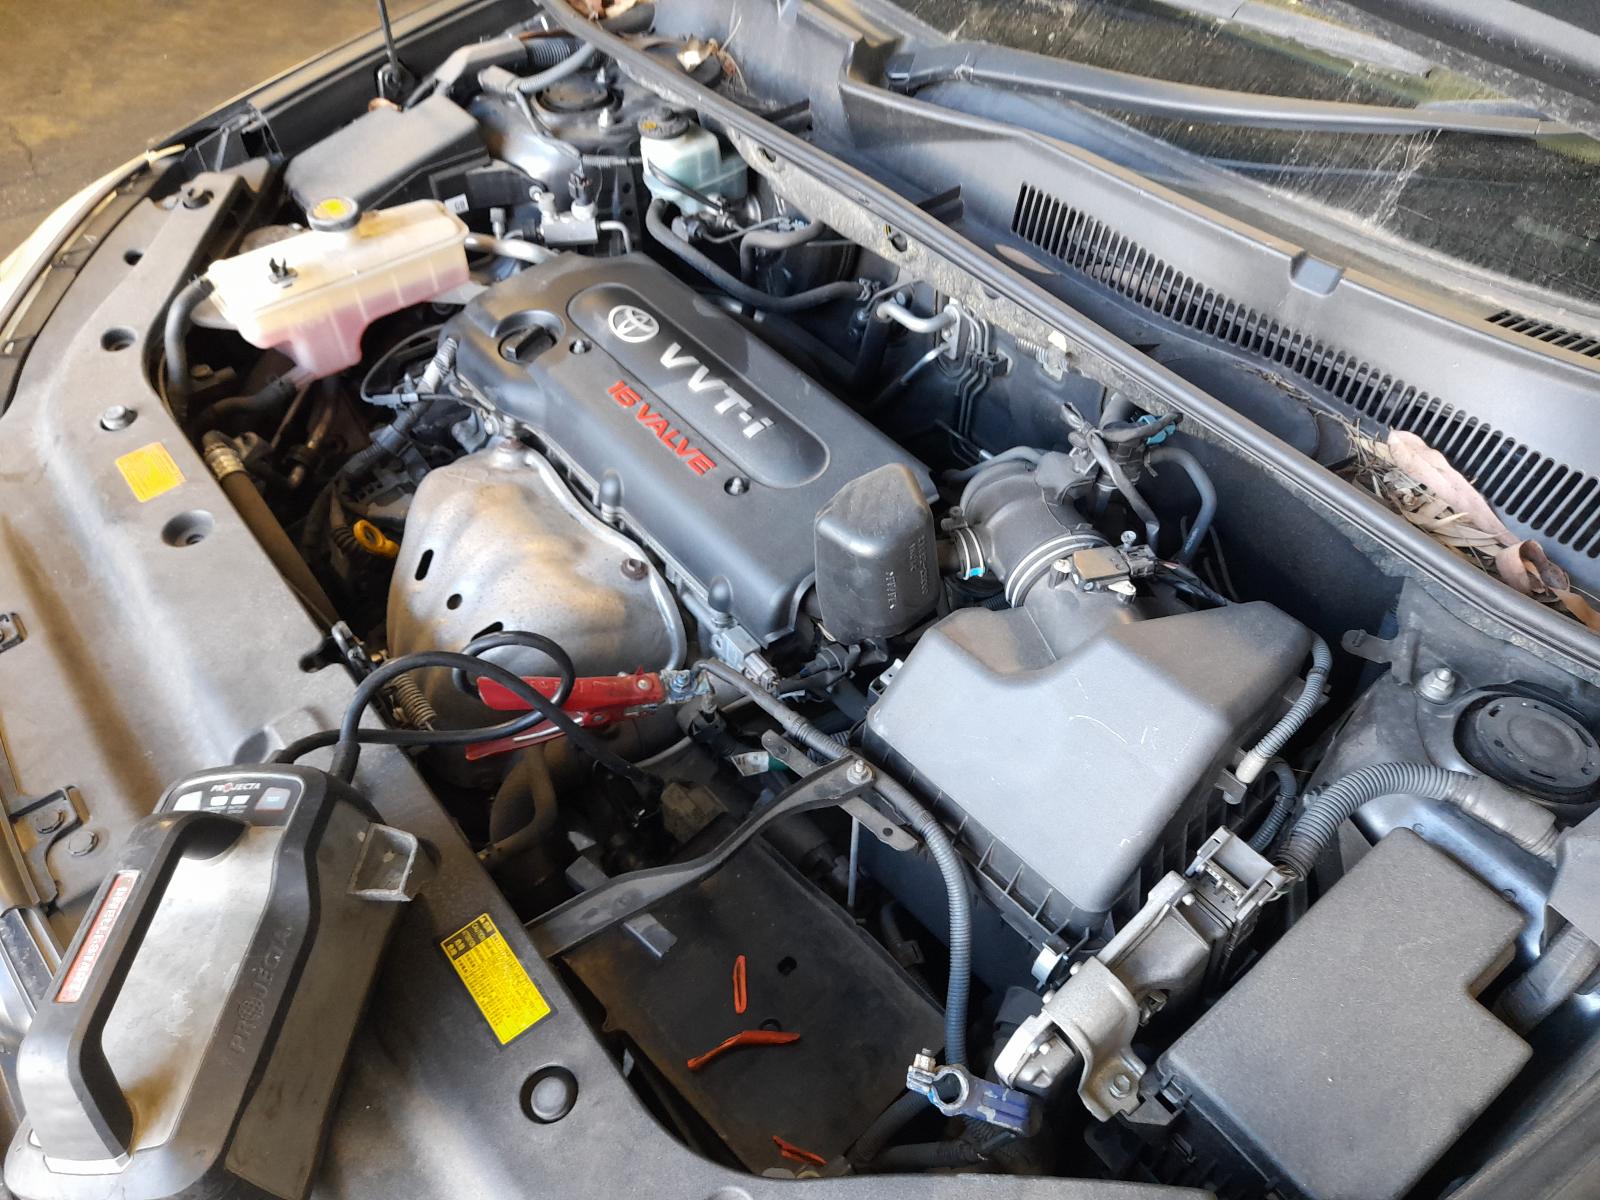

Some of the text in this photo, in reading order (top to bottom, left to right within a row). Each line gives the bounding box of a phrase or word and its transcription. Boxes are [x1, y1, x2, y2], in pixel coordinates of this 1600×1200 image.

[607, 379, 717, 476] 16 VALVE
[660, 342, 774, 438] VVT-i
[210, 782, 261, 793] PROJECTA
